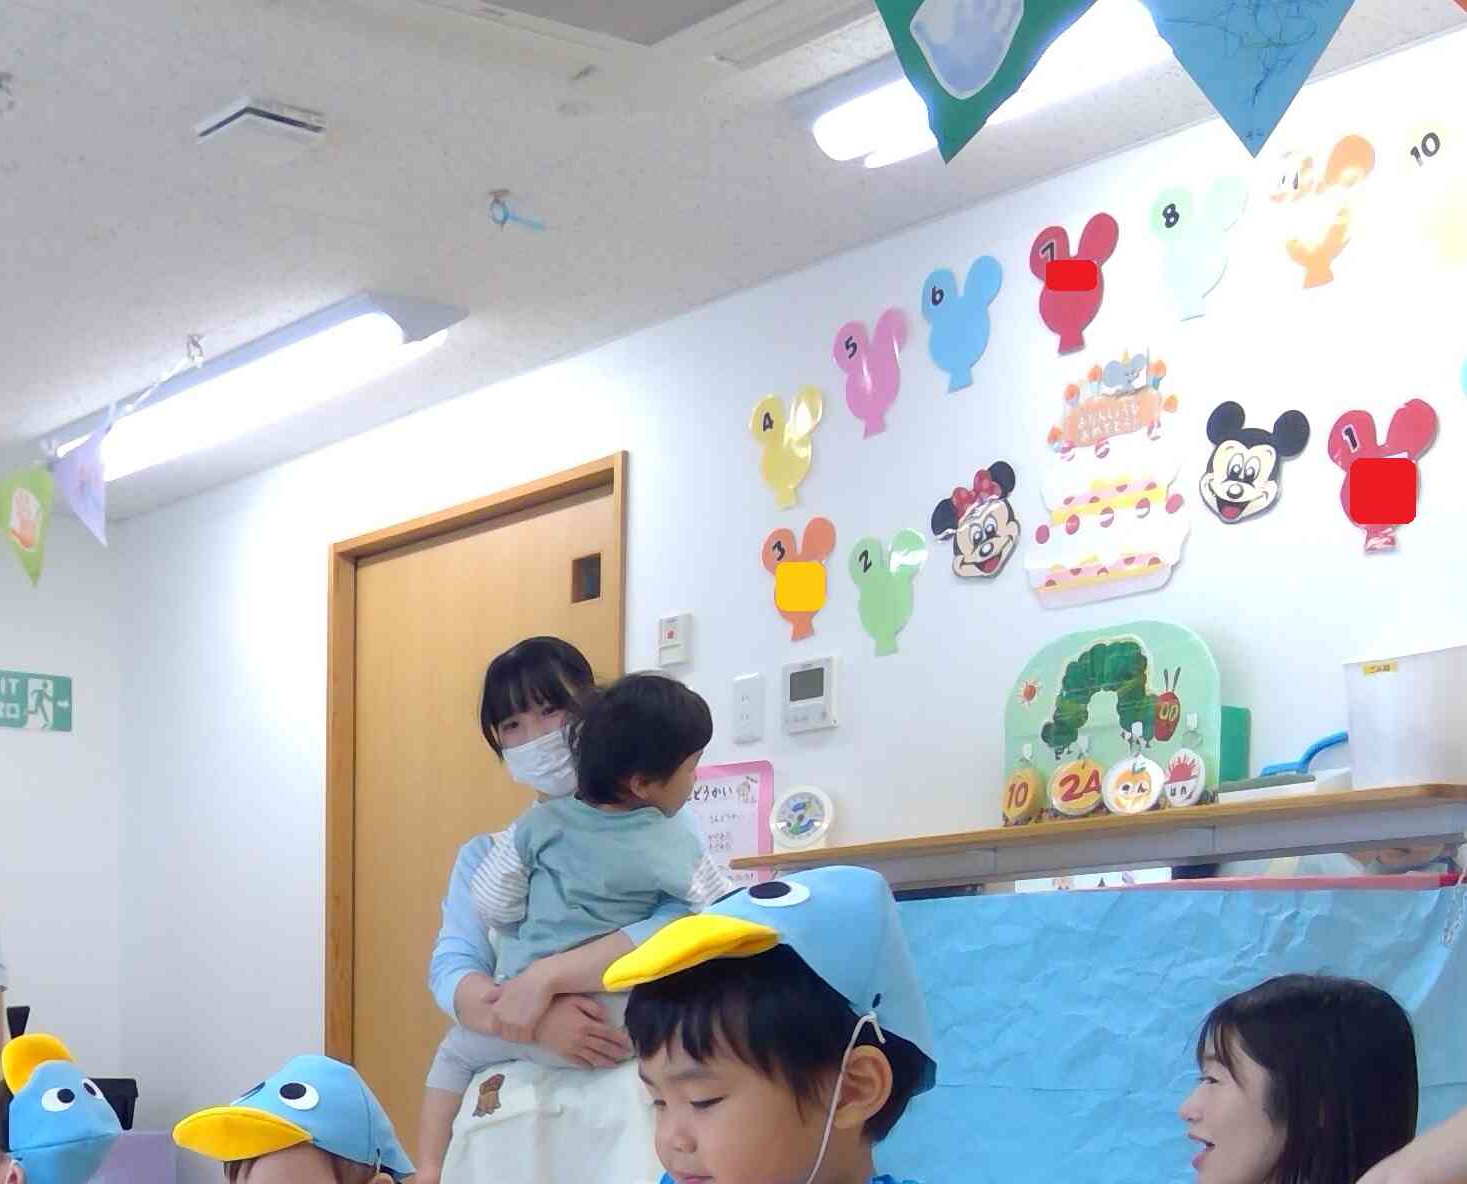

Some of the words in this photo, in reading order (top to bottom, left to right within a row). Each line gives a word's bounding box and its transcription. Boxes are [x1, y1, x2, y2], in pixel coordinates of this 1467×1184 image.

[1410, 132, 1441, 166] 10
[1162, 203, 1180, 228] 8
[1041, 241, 1055, 262] 7
[932, 286, 944, 306] 6
[845, 335, 857, 359] 5
[762, 412, 774, 432] 4
[1344, 426, 1358, 450] 1
[772, 540, 786, 561] 3
[858, 549, 872, 573] 2
[1007, 782, 1029, 809] 10
